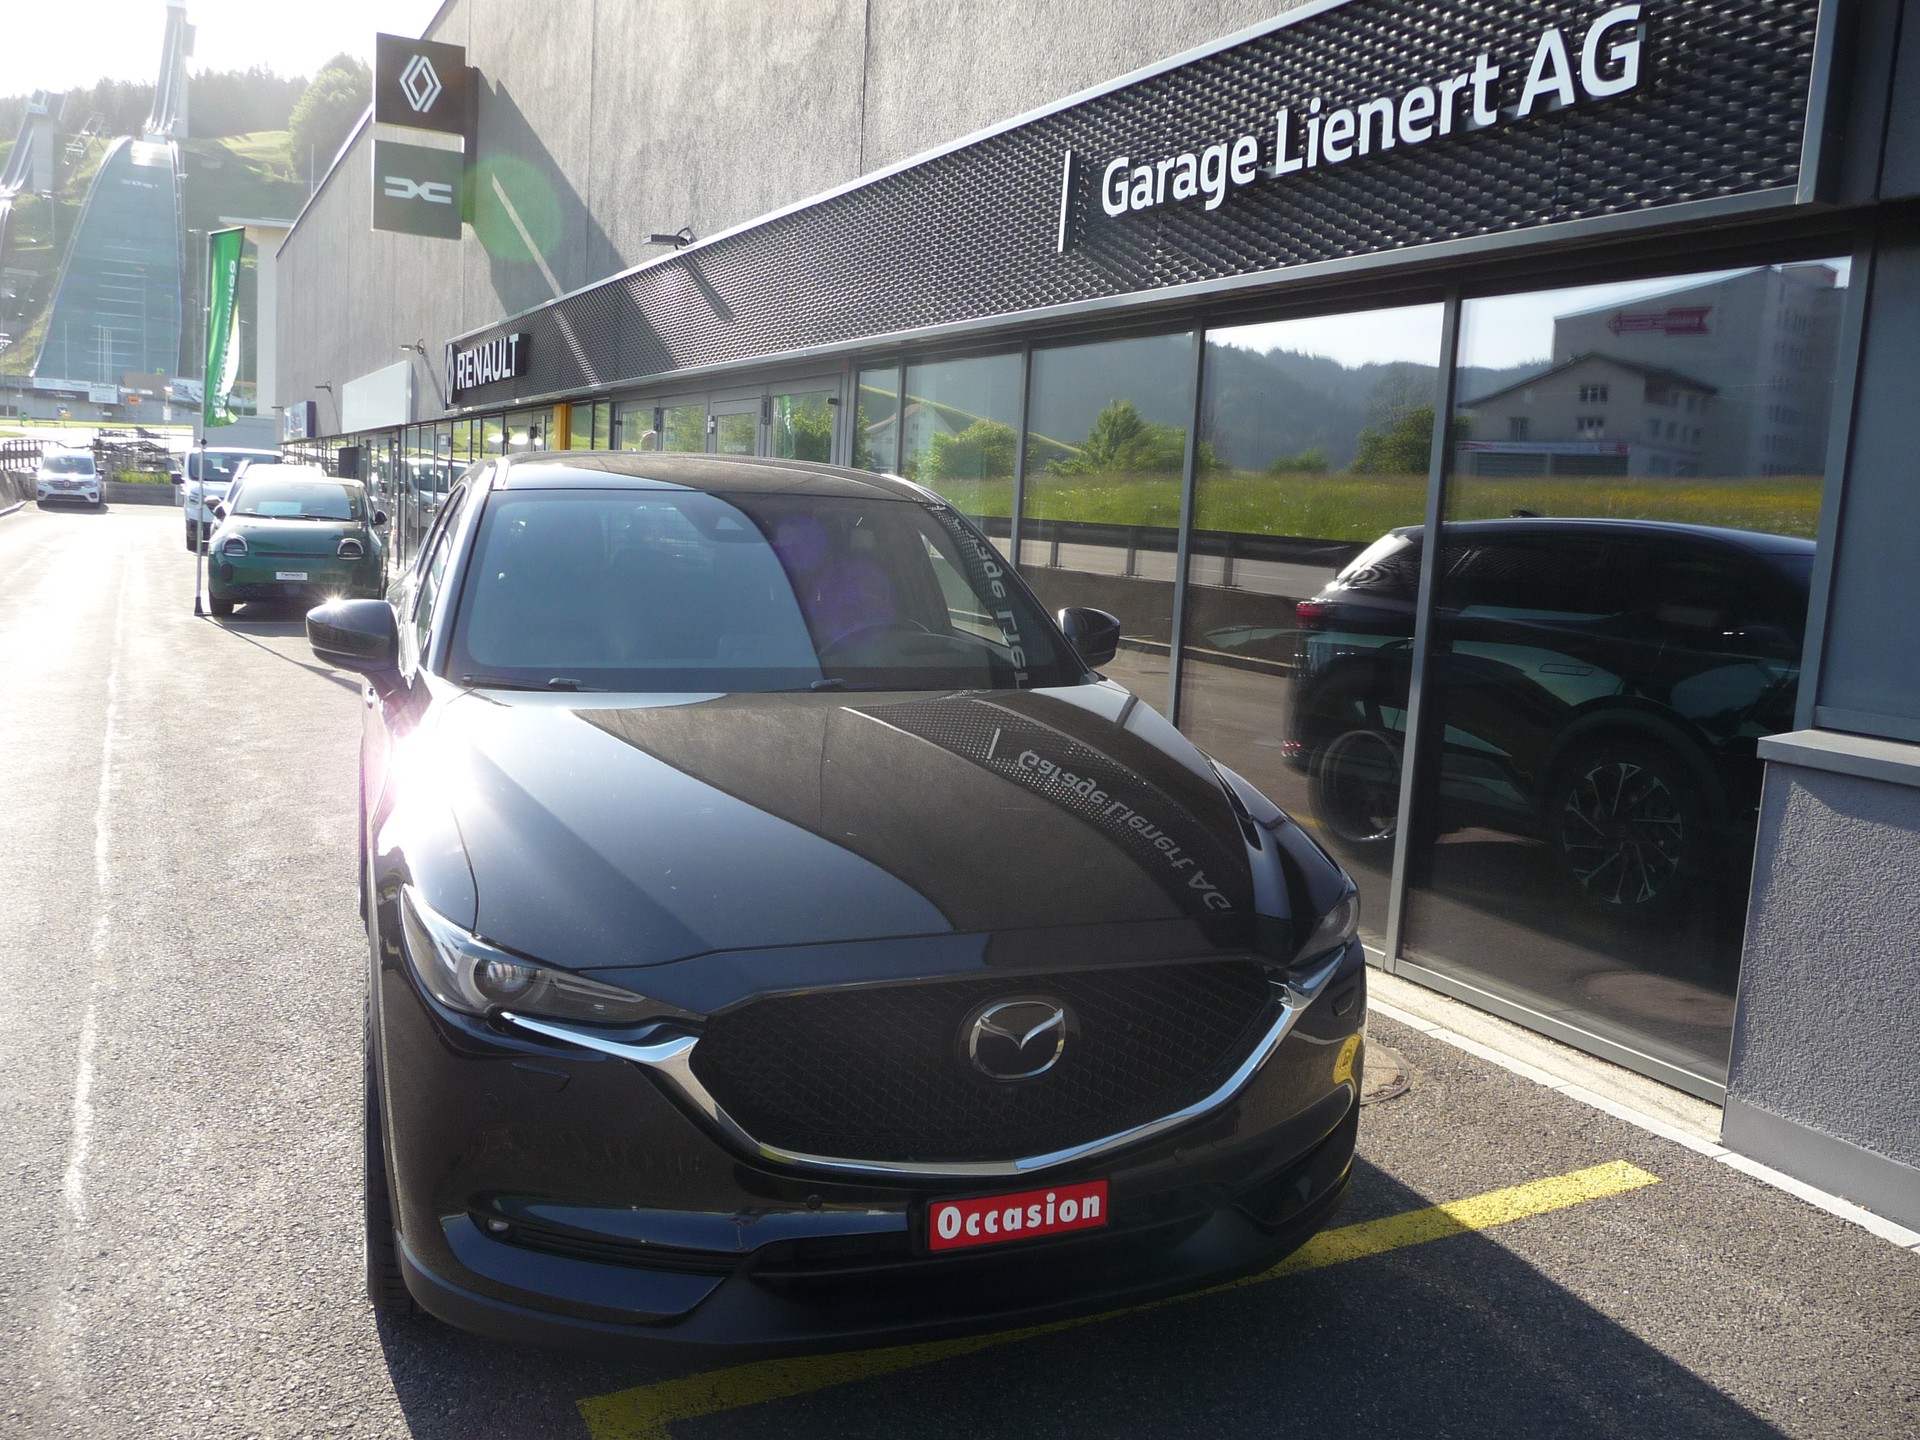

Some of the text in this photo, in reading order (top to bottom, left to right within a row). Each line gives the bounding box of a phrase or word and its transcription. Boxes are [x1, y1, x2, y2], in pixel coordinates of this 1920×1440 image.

[1102, 4, 1641, 217] Garage Lienert AG
[457, 333, 519, 390] RENAULT
[937, 1192, 1100, 1240] Occasion
